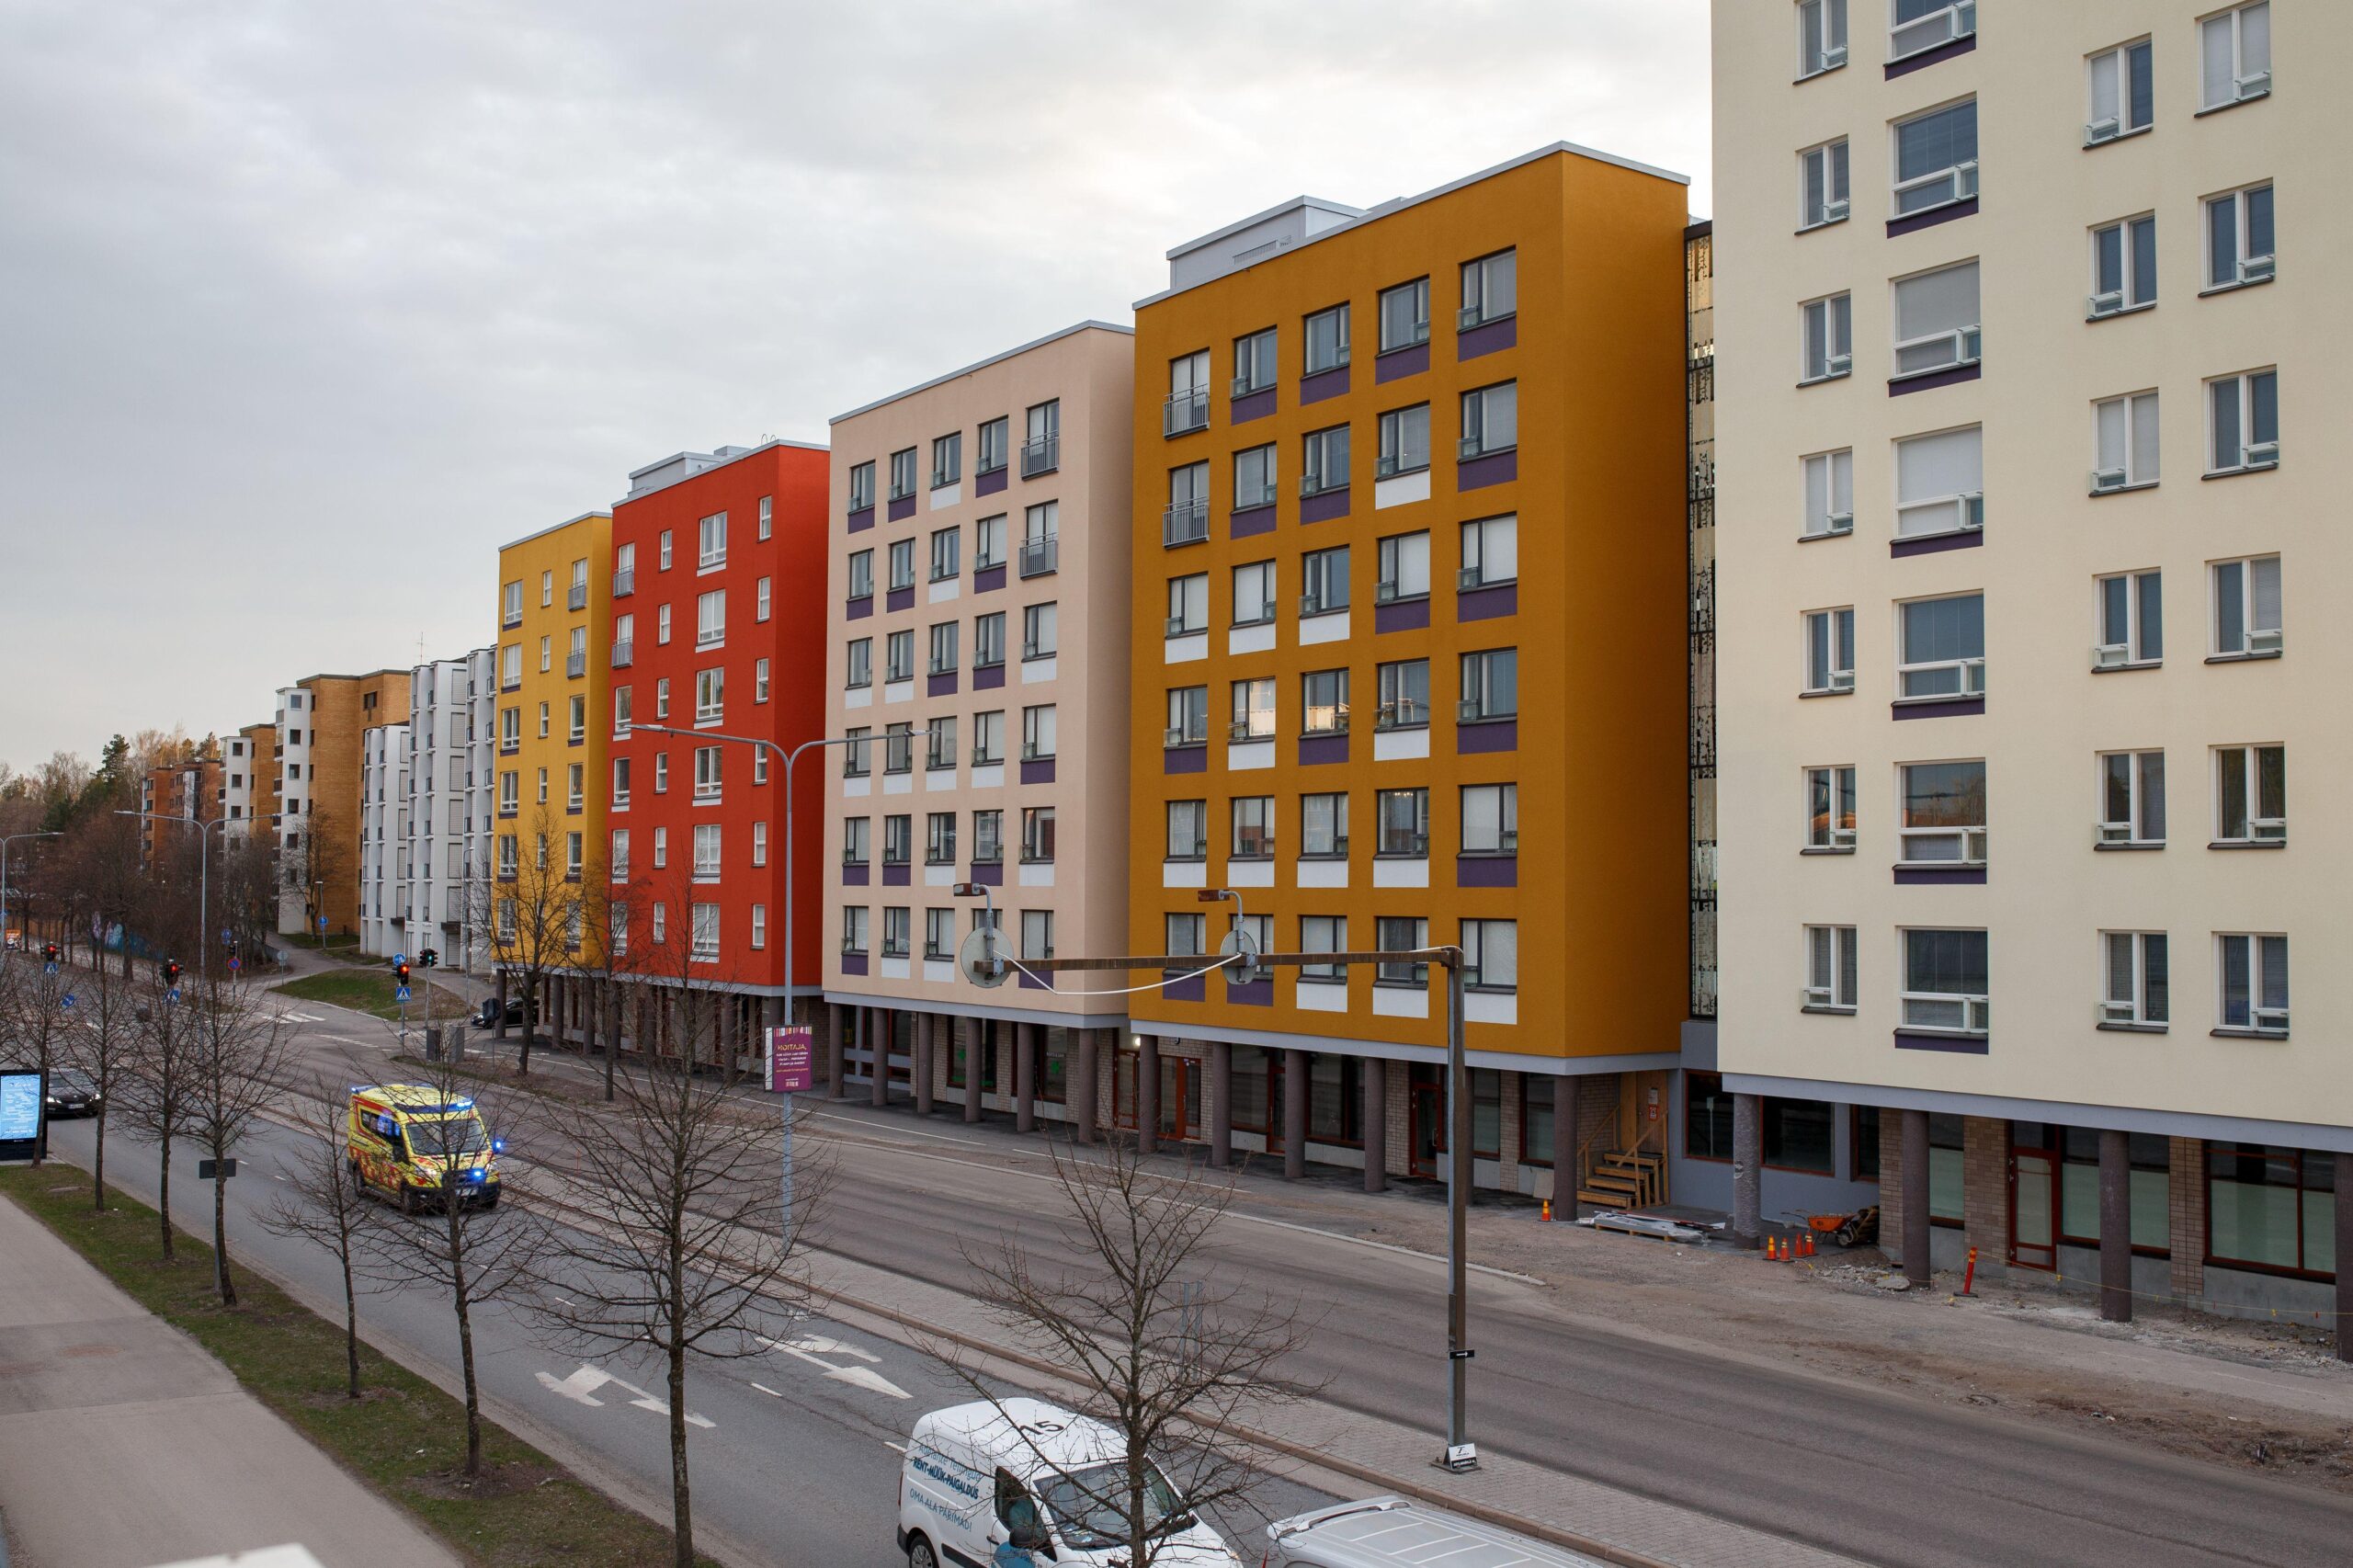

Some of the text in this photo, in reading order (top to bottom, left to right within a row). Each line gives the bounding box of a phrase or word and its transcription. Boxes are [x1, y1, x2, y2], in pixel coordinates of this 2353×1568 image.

[913, 1457, 979, 1499] RENT-MÜÜK-PAIGALDUS
[910, 1488, 924, 1505] OMA
[925, 1498, 938, 1513] ALA
